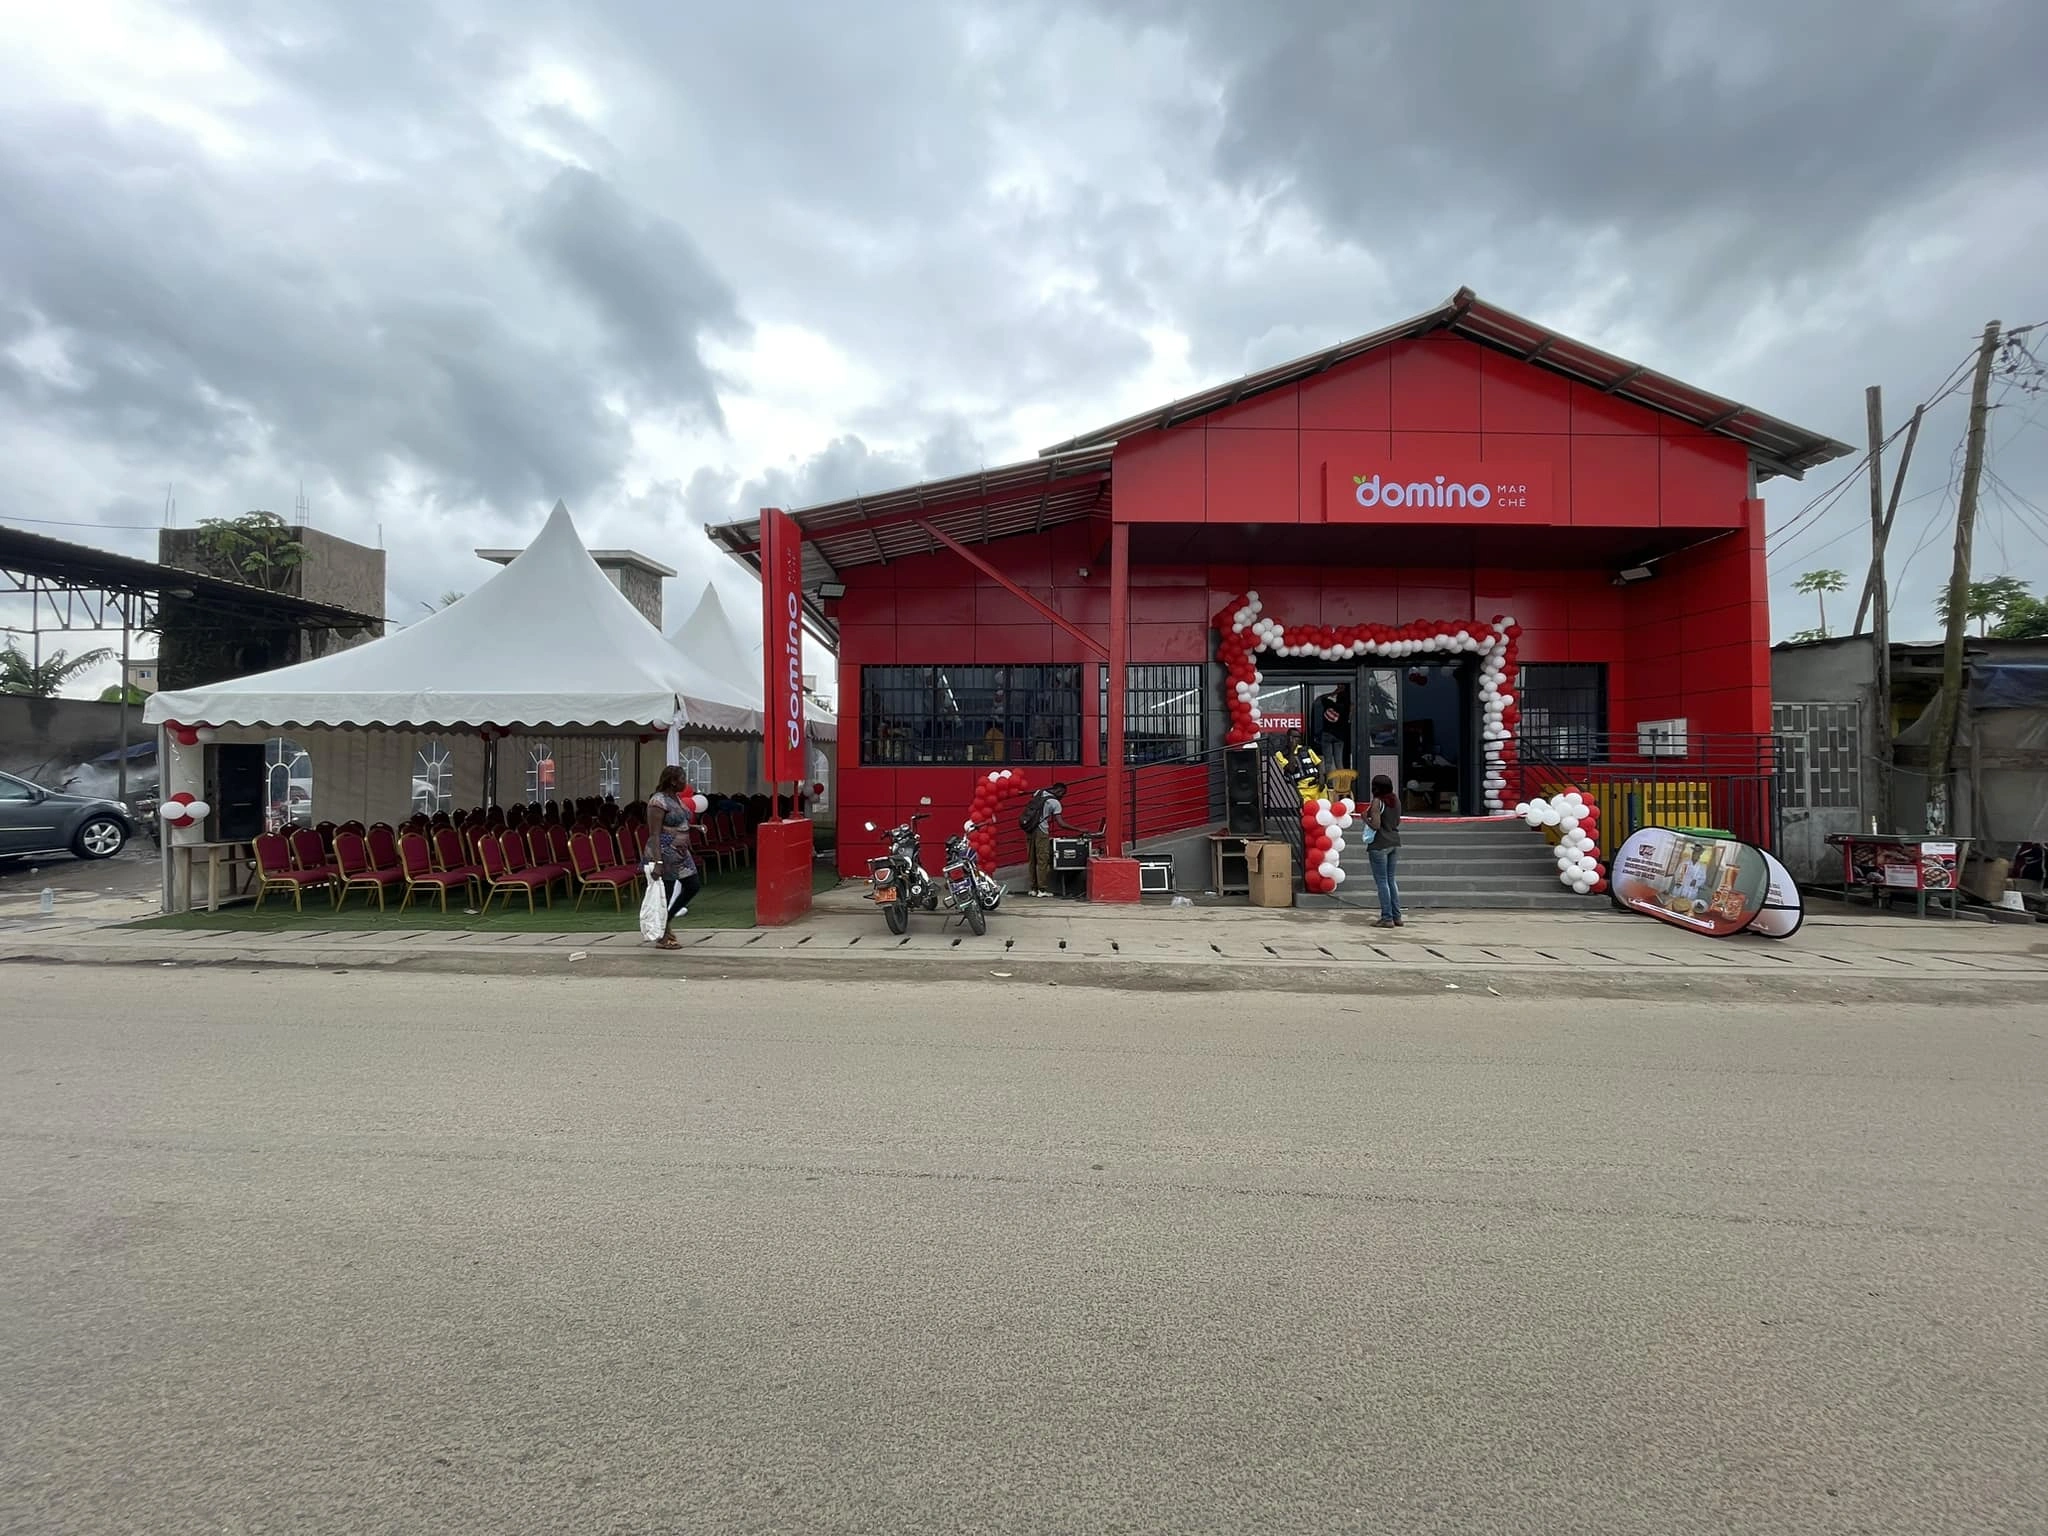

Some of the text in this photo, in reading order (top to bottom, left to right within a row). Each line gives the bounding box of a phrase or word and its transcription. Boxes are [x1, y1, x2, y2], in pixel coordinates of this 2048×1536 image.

[1355, 474, 1491, 508] domino
[1497, 484, 1527, 494] MAR
[786, 591, 799, 748] domino
